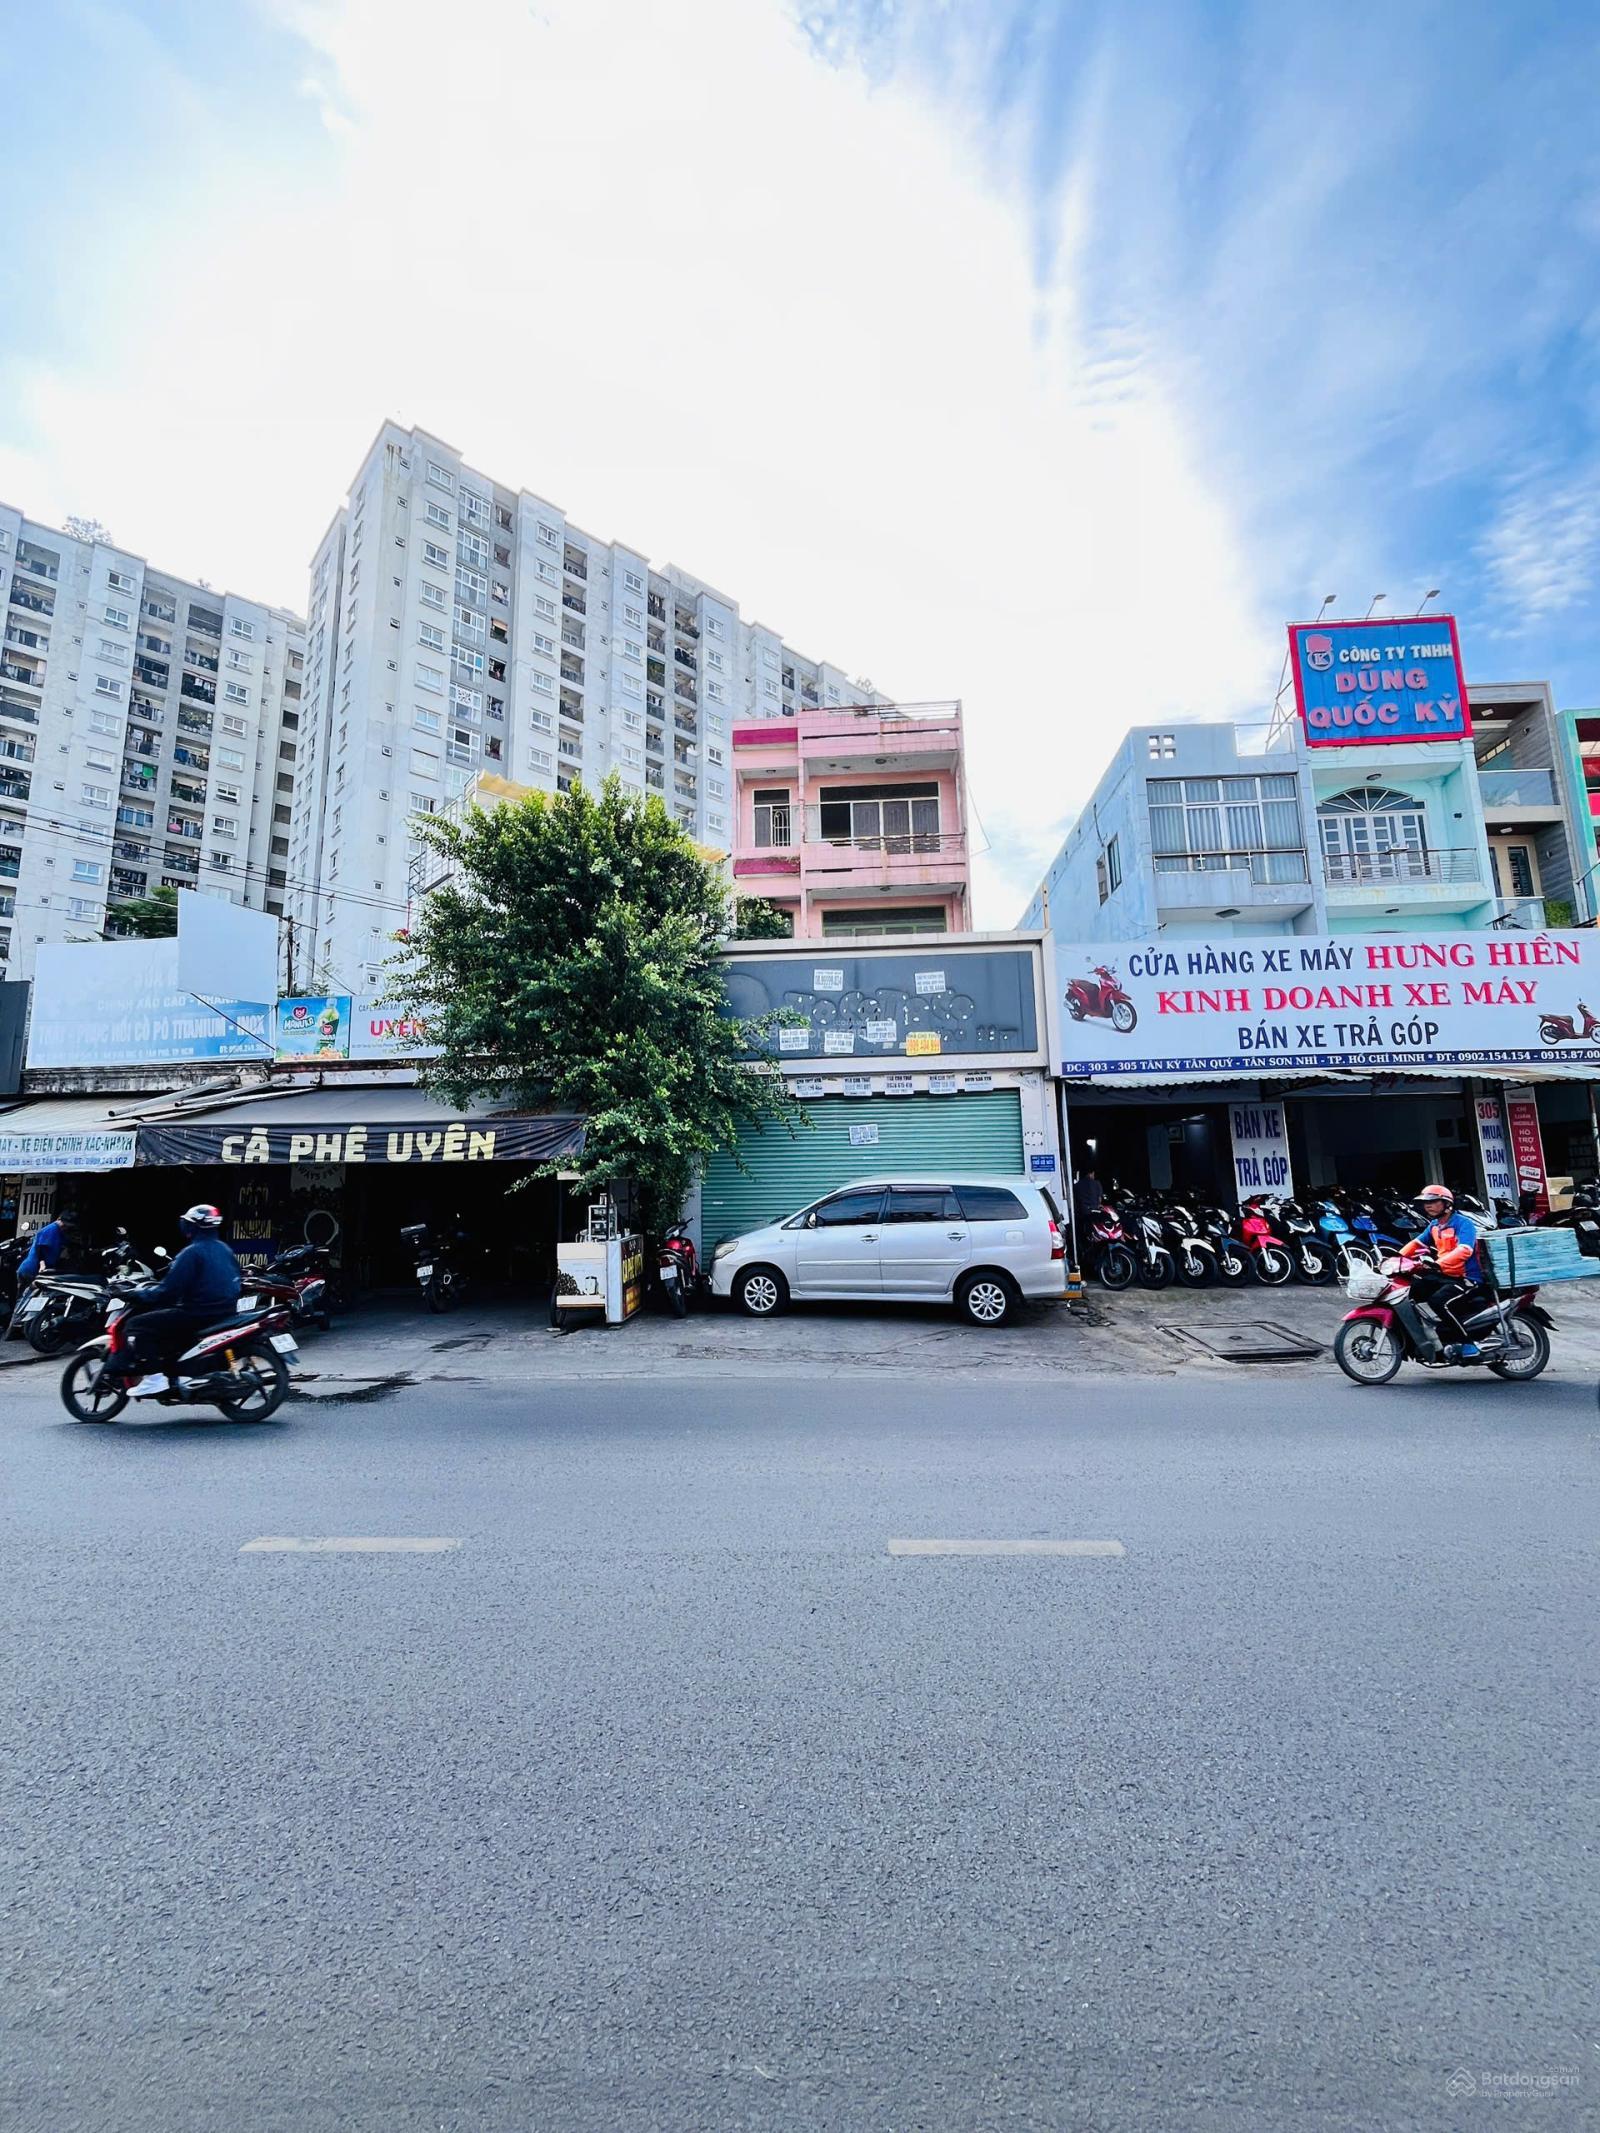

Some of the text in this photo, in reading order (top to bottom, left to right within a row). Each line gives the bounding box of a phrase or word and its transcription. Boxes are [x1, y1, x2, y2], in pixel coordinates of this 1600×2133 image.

[1339, 643, 1453, 663] CÔNG TY TNHH
[1336, 664, 1428, 693] DŨNG
[1309, 695, 1399, 728] QUỐC
[1129, 933, 1580, 976] CỬA HÀNG XE MÁY HƯNG HIỀN
[1156, 976, 1539, 1014] KINH DOANH XE MÁY
[172, 1016, 226, 1040] TITANIUM
[237, 1014, 265, 1036] INOX
[1239, 1014, 1439, 1050] BÁN XE TRẢ GÓP
[1066, 1064, 1085, 1073] ĐC:
[1088, 1063, 1107, 1072] 303
[1118, 1061, 1137, 1071] 305
[1140, 1060, 1162, 1070] TÂN
[1184, 1058, 1206, 1069] TÂN
[1243, 1057, 1266, 1067] TÂN
[1269, 1057, 1292, 1066] SƠN
[1327, 1056, 1346, 1065] TP.
[1393, 1054, 1425, 1063] MINH
[1436, 1053, 1455, 1062] ĐT:
[1458, 1051, 1531, 1061] 0902.154.154
[1234, 1105, 1281, 1138] BÁN XE
[1478, 1102, 1500, 1119] 305
[289, 1125, 368, 1163] PHÊ
[387, 1123, 496, 1162] UYÊN
[1482, 1125, 1502, 1139] MUA
[1236, 1147, 1287, 1187] TRẢ GÓP
[1486, 1146, 1505, 1163] BÁN
[1487, 1173, 1509, 1187] TRAO
